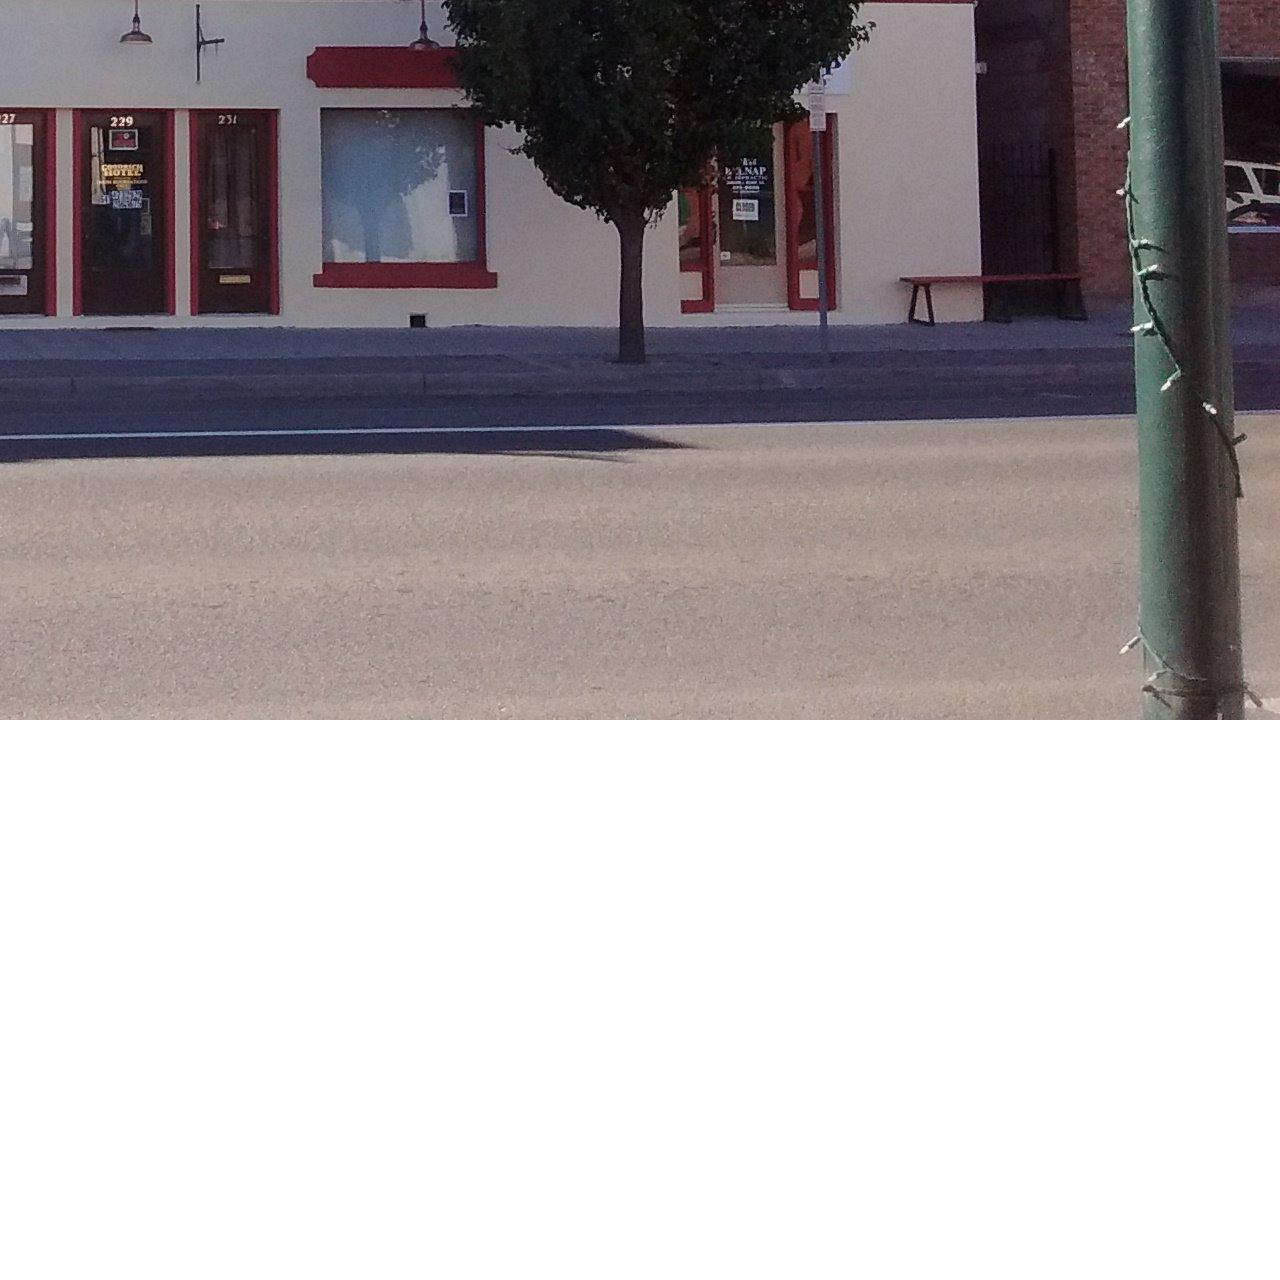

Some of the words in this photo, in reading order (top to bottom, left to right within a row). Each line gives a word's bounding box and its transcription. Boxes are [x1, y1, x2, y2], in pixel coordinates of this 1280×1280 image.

[110, 116, 134, 127] 229
[218, 114, 237, 125] 231
[103, 168, 142, 177] HOTEL
